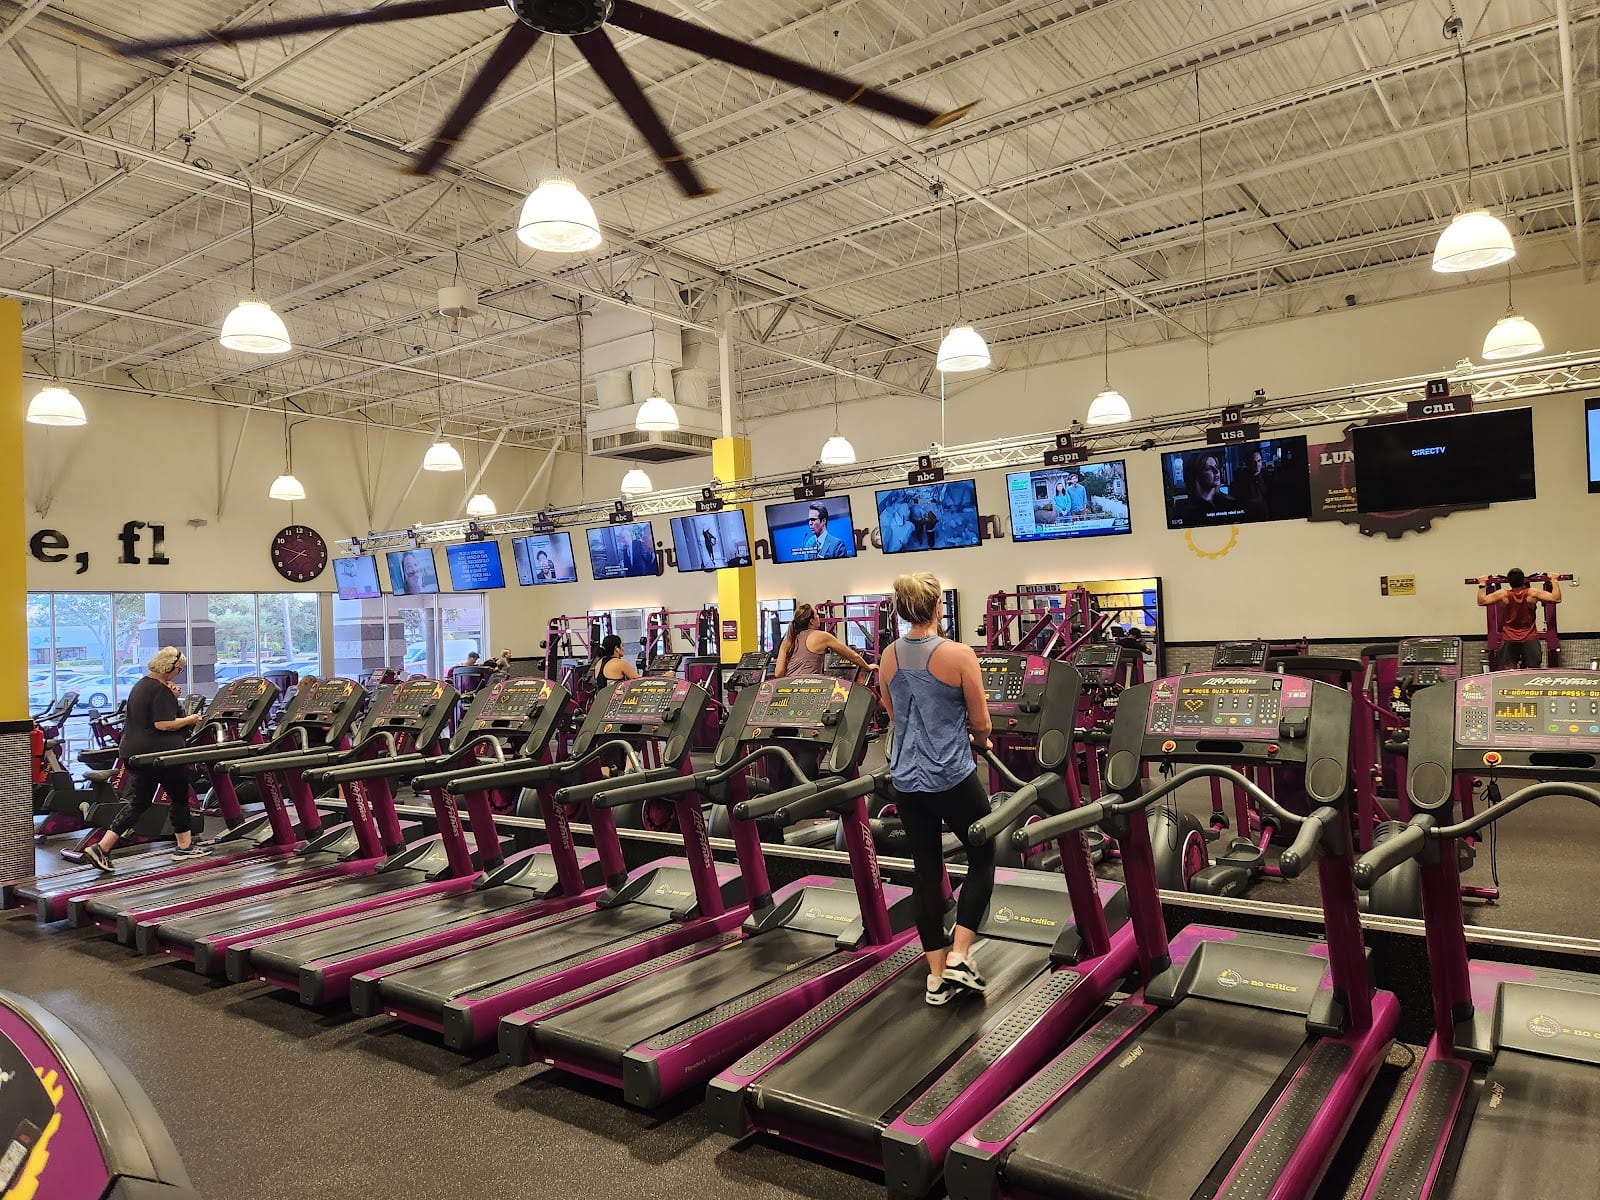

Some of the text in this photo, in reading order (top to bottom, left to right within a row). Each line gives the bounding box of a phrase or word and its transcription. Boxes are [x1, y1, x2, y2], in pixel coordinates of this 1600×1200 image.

[1432, 384, 1444, 394] 11
[1422, 402, 1455, 414] cnn
[1225, 412, 1237, 422] 10
[1220, 428, 1245, 440] usa
[1060, 437, 1068, 446] 9
[1412, 446, 1446, 456] DIRECTV
[1052, 451, 1079, 464] espn
[1320, 450, 1354, 465] LUN
[917, 471, 934, 482] nbc
[805, 488, 814, 496] fx
[700, 502, 717, 511] hgtv
[1266, 982, 1298, 992] critics
